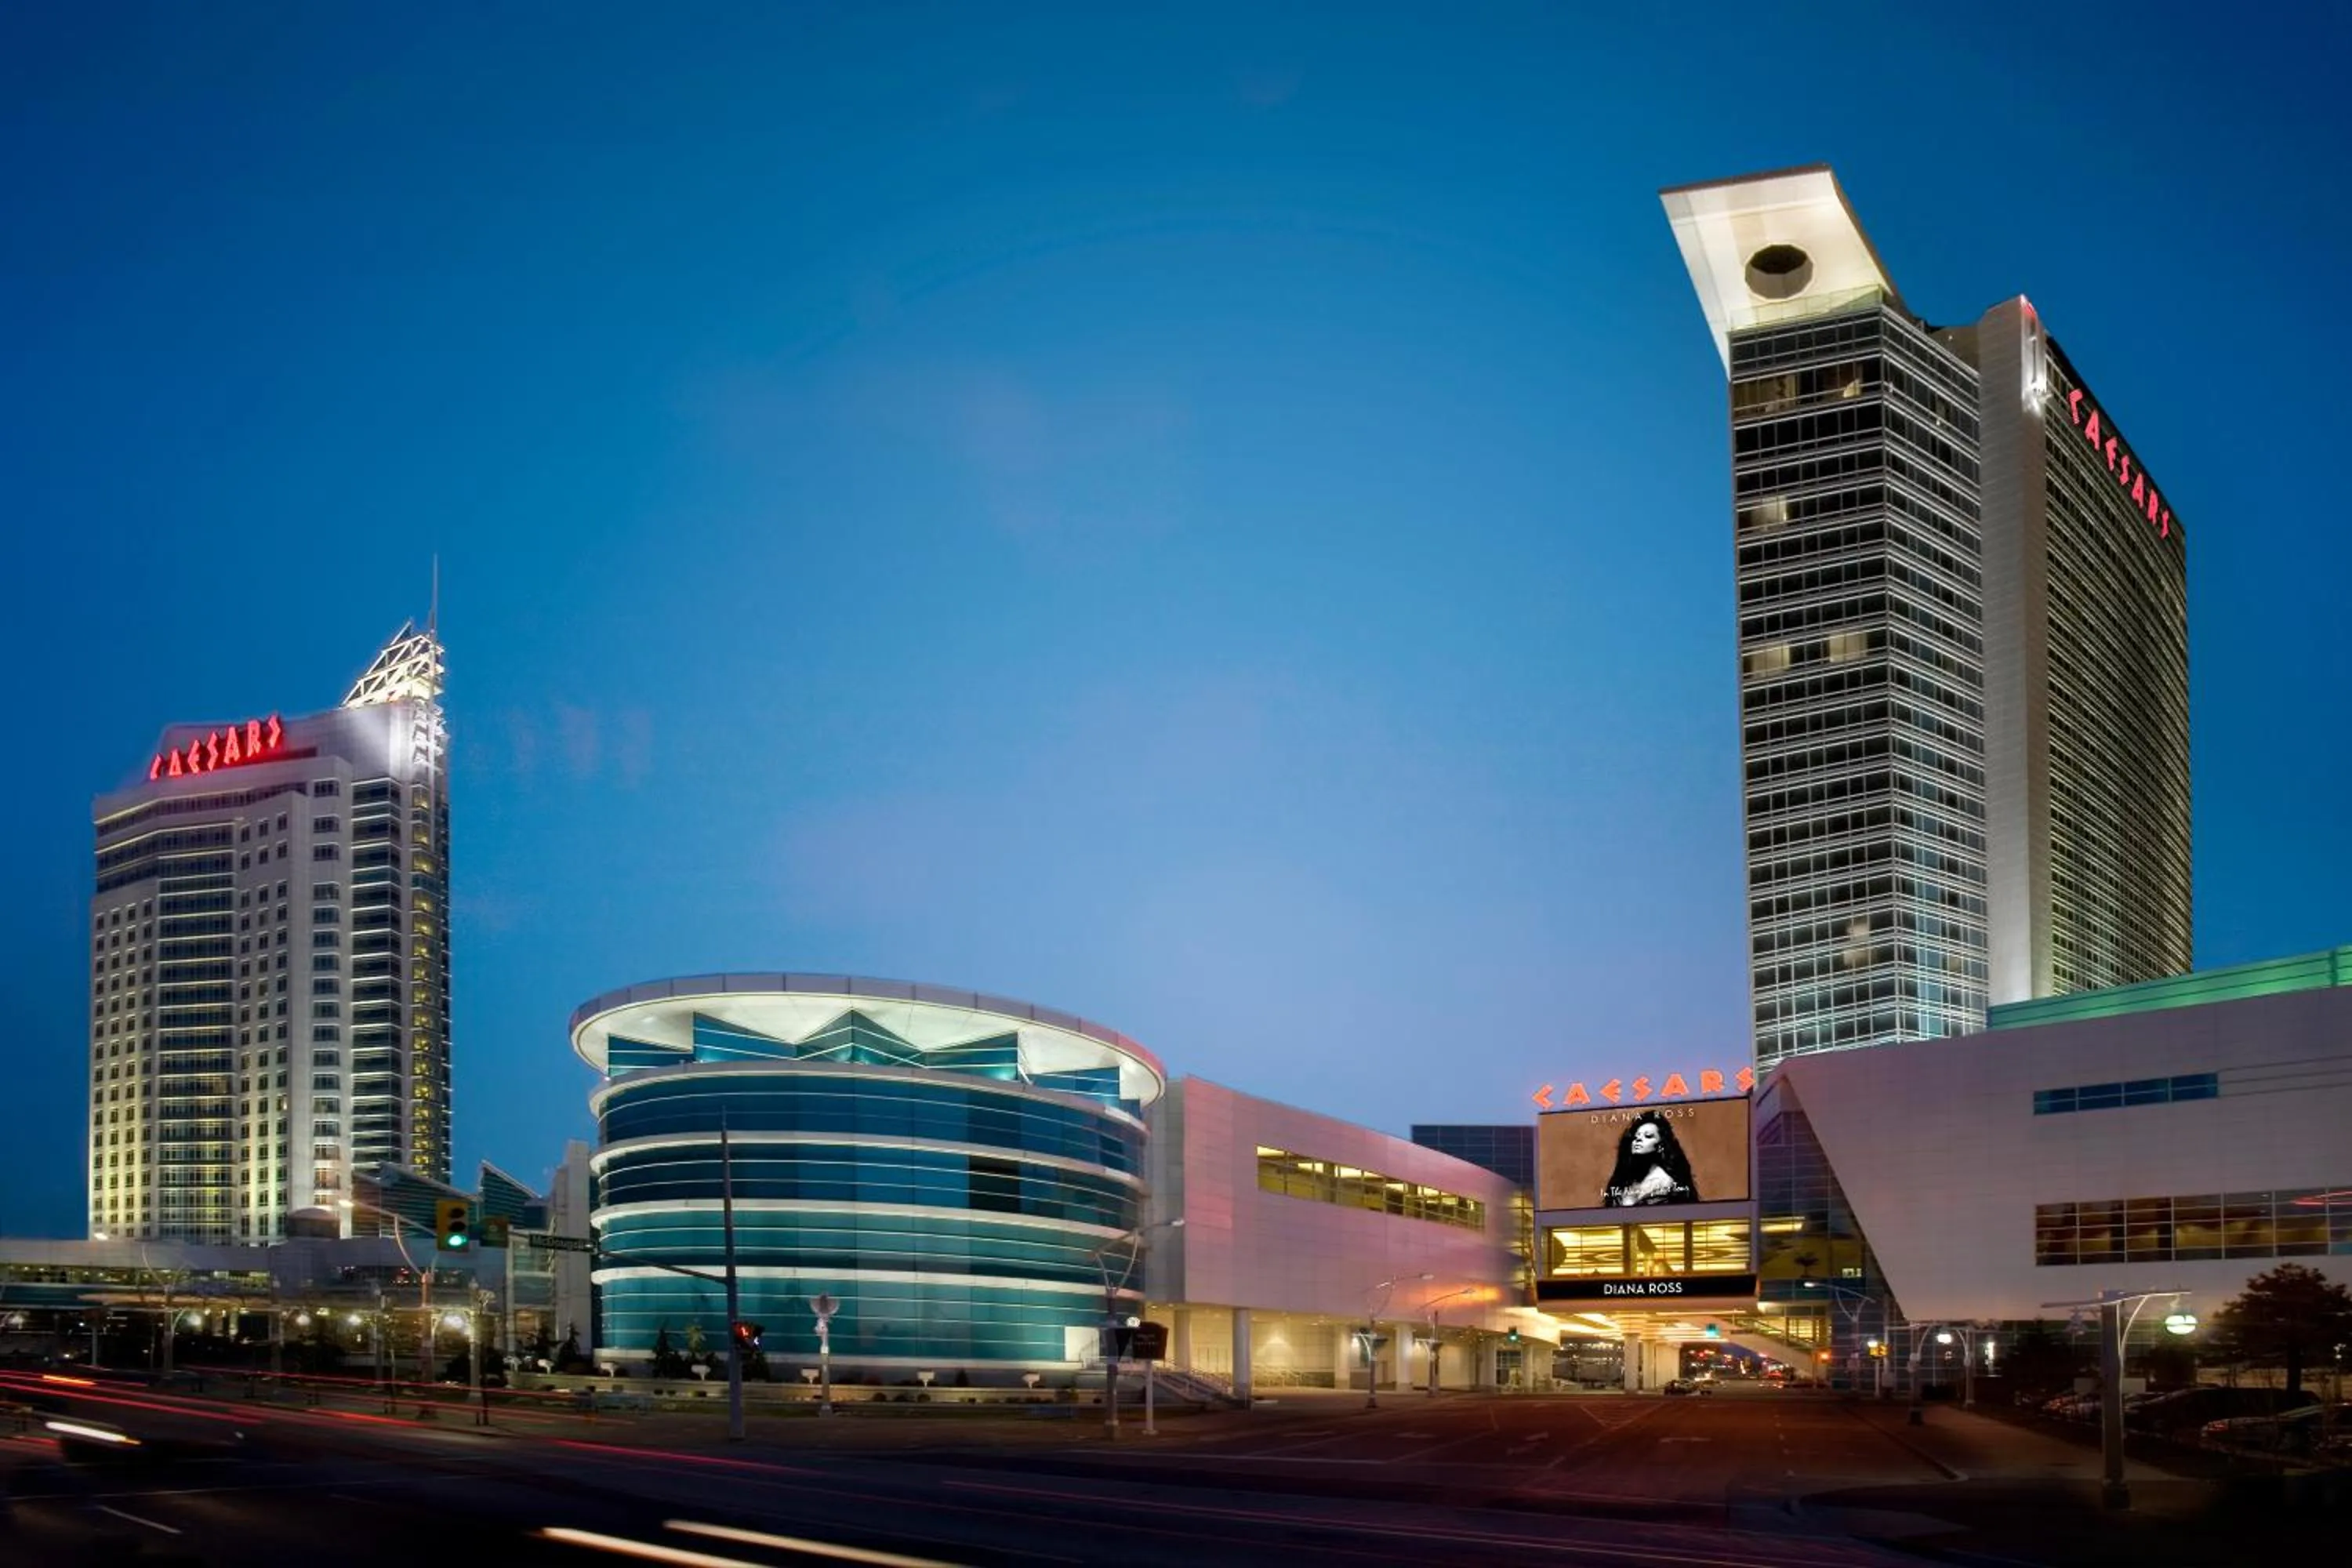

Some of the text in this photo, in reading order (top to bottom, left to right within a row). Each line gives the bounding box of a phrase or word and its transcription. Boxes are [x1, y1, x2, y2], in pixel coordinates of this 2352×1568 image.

[2069, 389, 2169, 539] CAESARS
[151, 714, 281, 779] CAESARS
[1533, 1067, 1755, 1109] CAESARS
[1591, 1109, 1694, 1123] DIANA ROSS
[1603, 1282, 1682, 1294] DIANA ROSS
